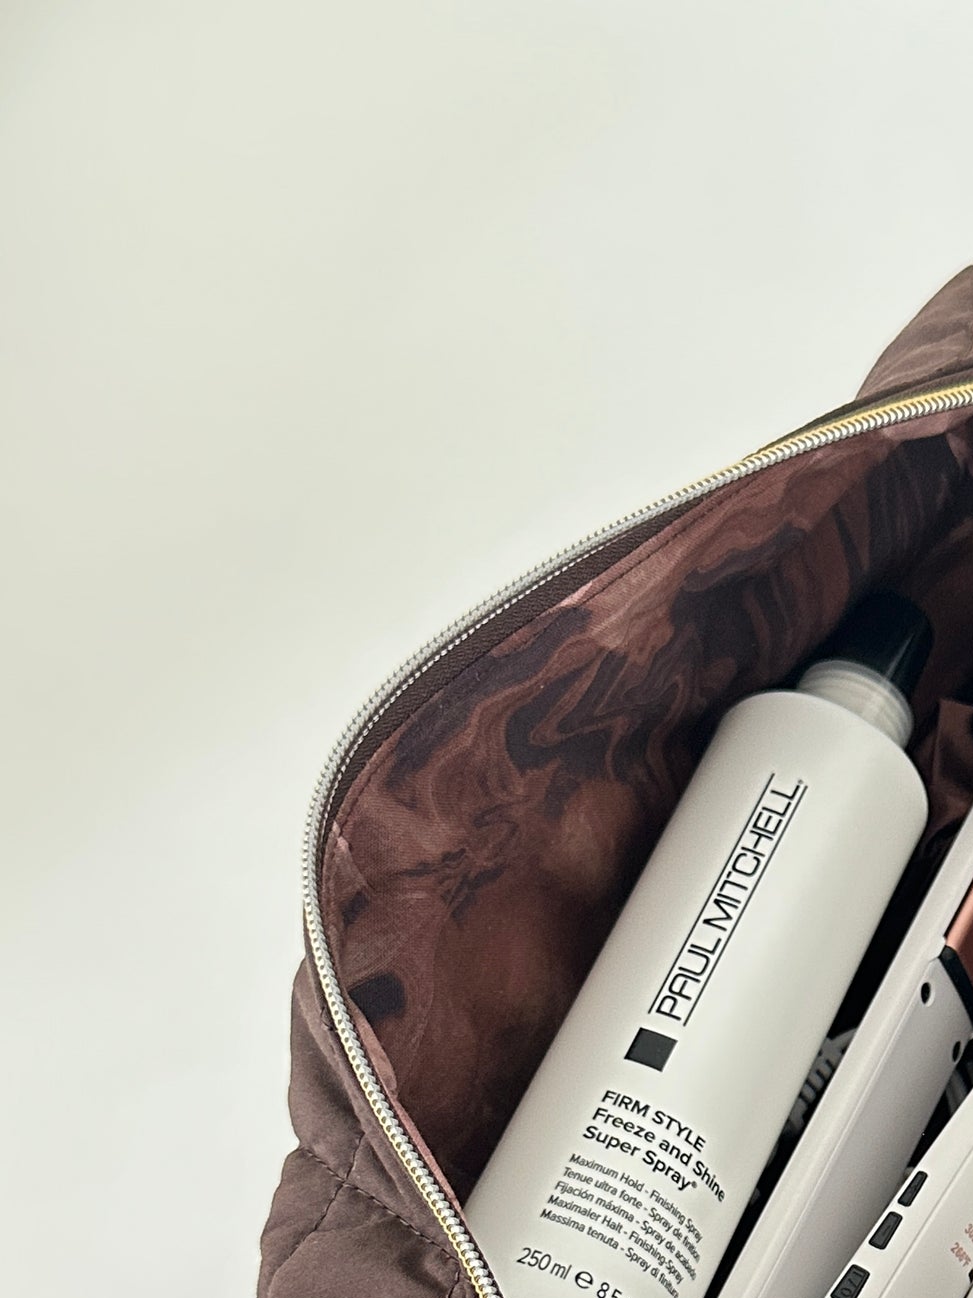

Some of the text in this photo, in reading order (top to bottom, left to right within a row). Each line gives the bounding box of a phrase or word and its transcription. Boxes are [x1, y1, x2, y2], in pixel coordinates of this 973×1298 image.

[656, 784, 800, 1021] PAUL MITCHELL
[583, 1126, 641, 1157] Super
[592, 1107, 726, 1202] Freeze and Shine
[601, 1090, 706, 1153] FIRM STYLE
[547, 1194, 602, 1221] Maximaler
[601, 1215, 623, 1234] Halt
[554, 1180, 594, 1202] Fijación
[595, 1197, 635, 1222] máxima
[640, 1220, 666, 1245] Spray
[665, 1241, 676, 1253] de
[563, 1167, 593, 1185] Tenue
[594, 1179, 618, 1196] ultra
[619, 1189, 643, 1209] forte
[648, 1207, 673, 1232] Spray
[672, 1228, 682, 1240] de
[569, 1153, 619, 1179] Maximum
[620, 1172, 645, 1192] Hold
[650, 1190, 686, 1225] Finishing
[685, 1218, 703, 1243] Spray
[516, 1247, 552, 1271] 250
[550, 1263, 572, 1279] ml
[540, 1208, 586, 1233] Massima
[586, 1227, 619, 1249] tenuta
[625, 1247, 651, 1272] Spray
